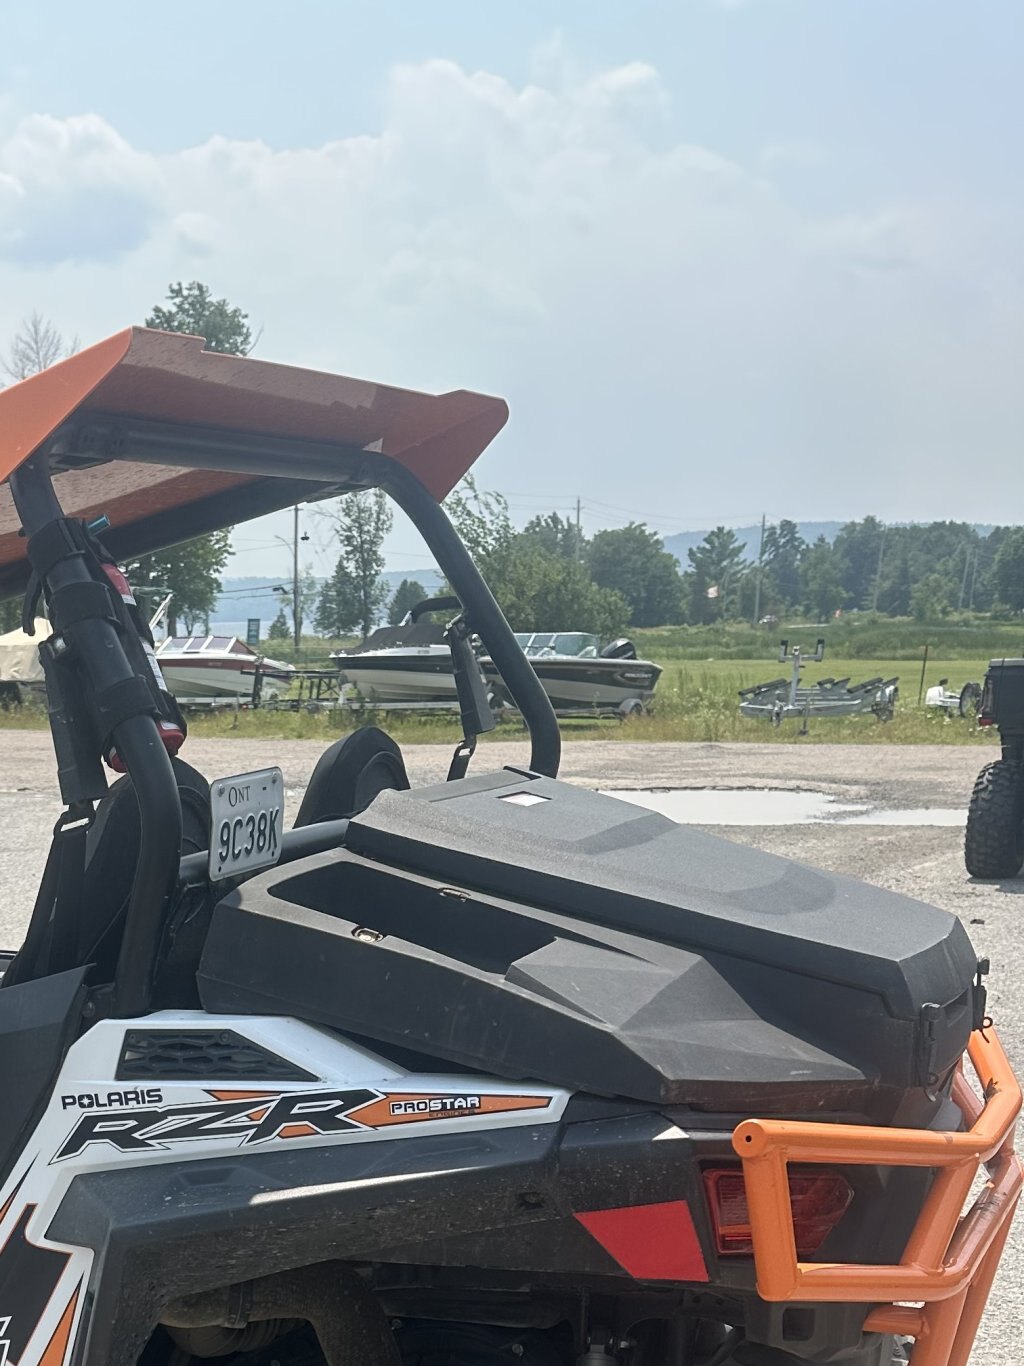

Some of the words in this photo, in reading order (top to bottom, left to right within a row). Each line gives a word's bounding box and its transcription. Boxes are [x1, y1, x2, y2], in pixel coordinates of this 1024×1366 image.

[218, 808, 280, 862] 9C38K
[61, 1088, 164, 1110] POLARIS
[390, 1096, 481, 1116] PROSTAR
[49, 1088, 387, 1165] RZR
